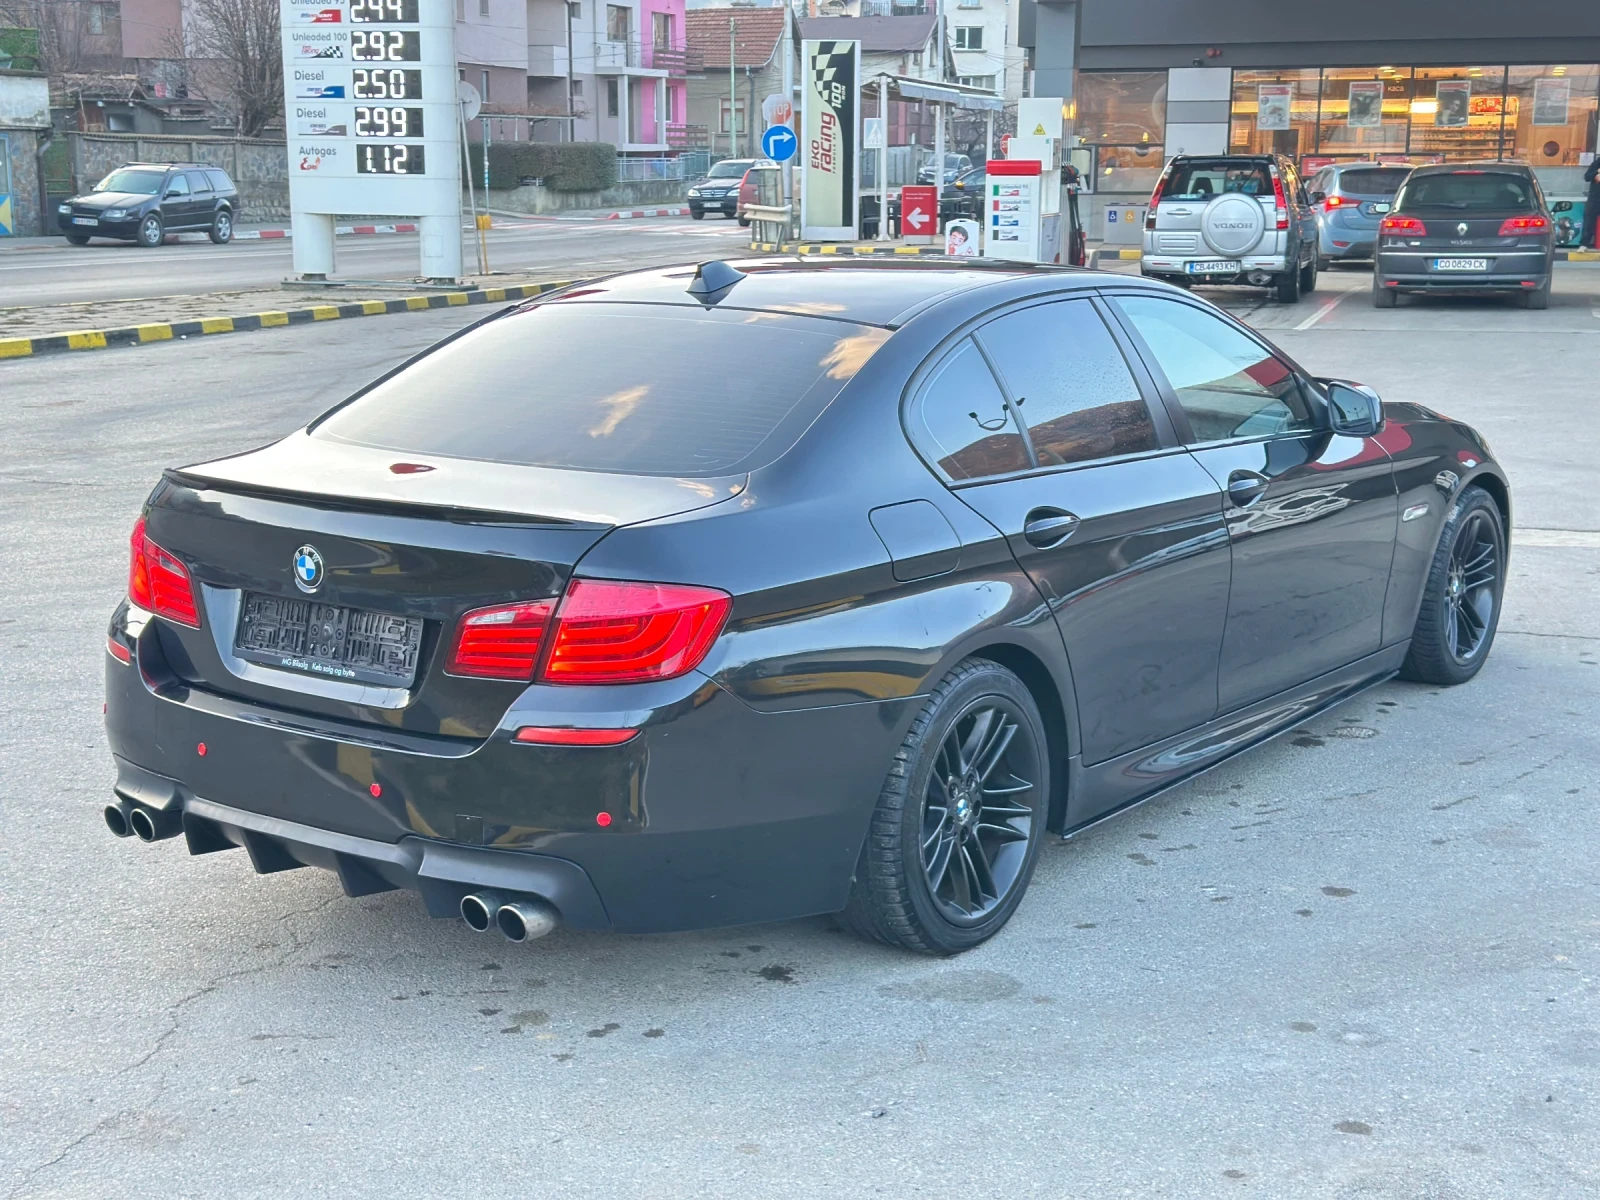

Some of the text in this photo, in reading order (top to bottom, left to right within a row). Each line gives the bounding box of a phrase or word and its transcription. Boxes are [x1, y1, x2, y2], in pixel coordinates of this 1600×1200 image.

[292, 32, 347, 41] Unleaded 100
[352, 31, 403, 60] 2.92
[294, 70, 324, 81] Diesel
[353, 69, 405, 98] 2.50
[831, 81, 842, 108] 100
[296, 108, 326, 118] Diesel
[355, 107, 407, 136] 2.99
[299, 146, 337, 158] Autogas
[811, 139, 820, 170] EKO
[820, 111, 837, 172] racing
[366, 144, 408, 174] 1.12
[295, 547, 320, 563] BMW
[282, 658, 292, 666] MG
[334, 668, 342, 676] og
